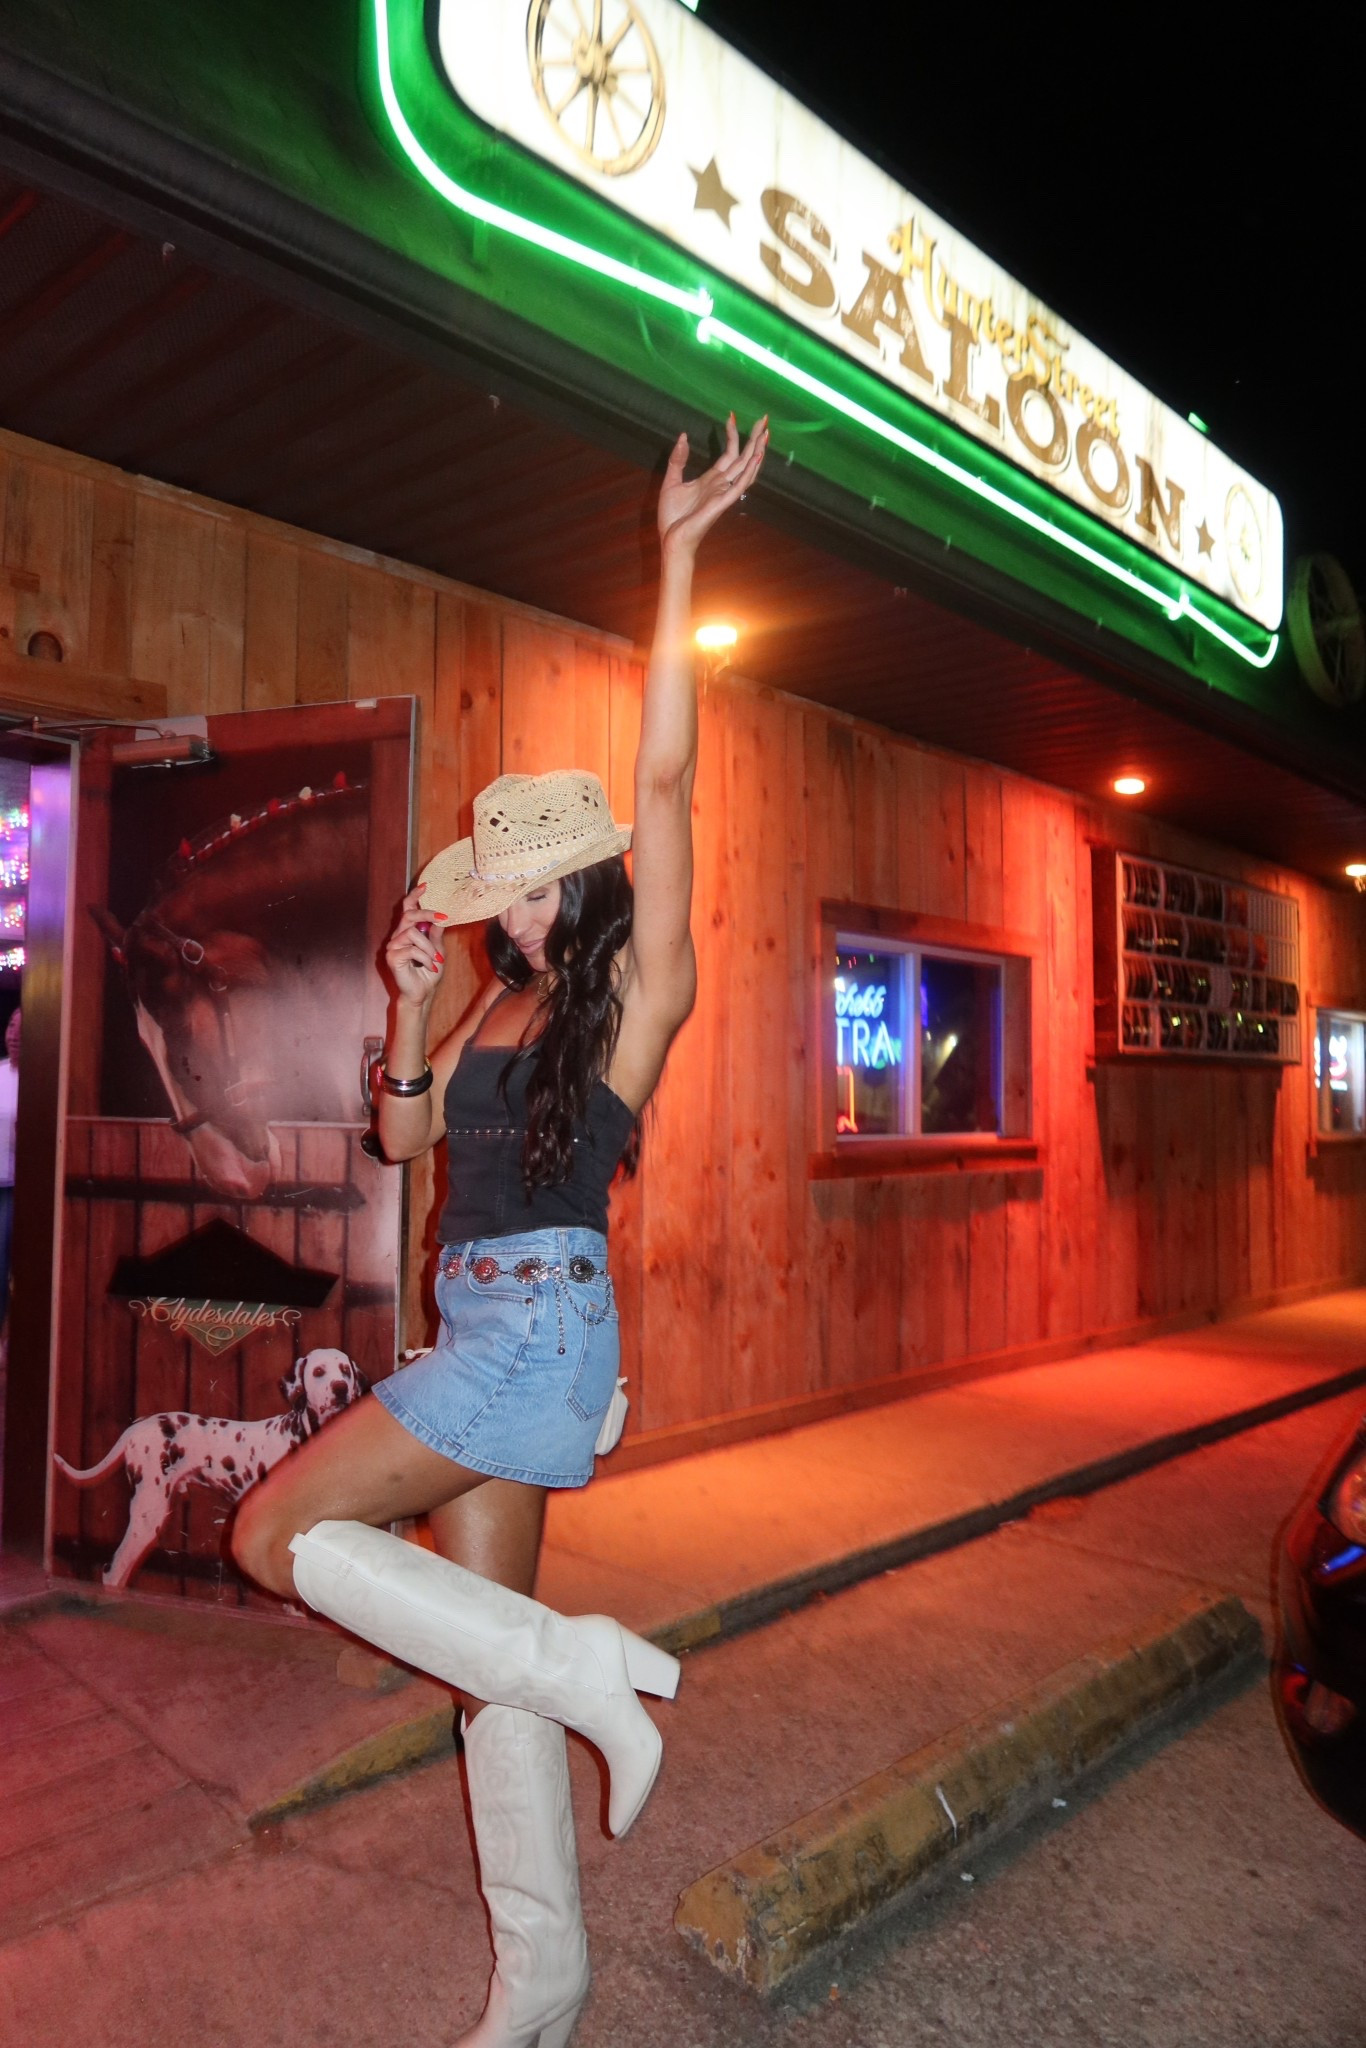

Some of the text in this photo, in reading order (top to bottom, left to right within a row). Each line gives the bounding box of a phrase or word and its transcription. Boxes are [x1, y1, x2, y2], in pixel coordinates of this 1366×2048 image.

[759, 187, 1186, 553] SALOON
[887, 214, 1120, 438] Hunter Street
[138, 1297, 290, 1338] Clydesdales
